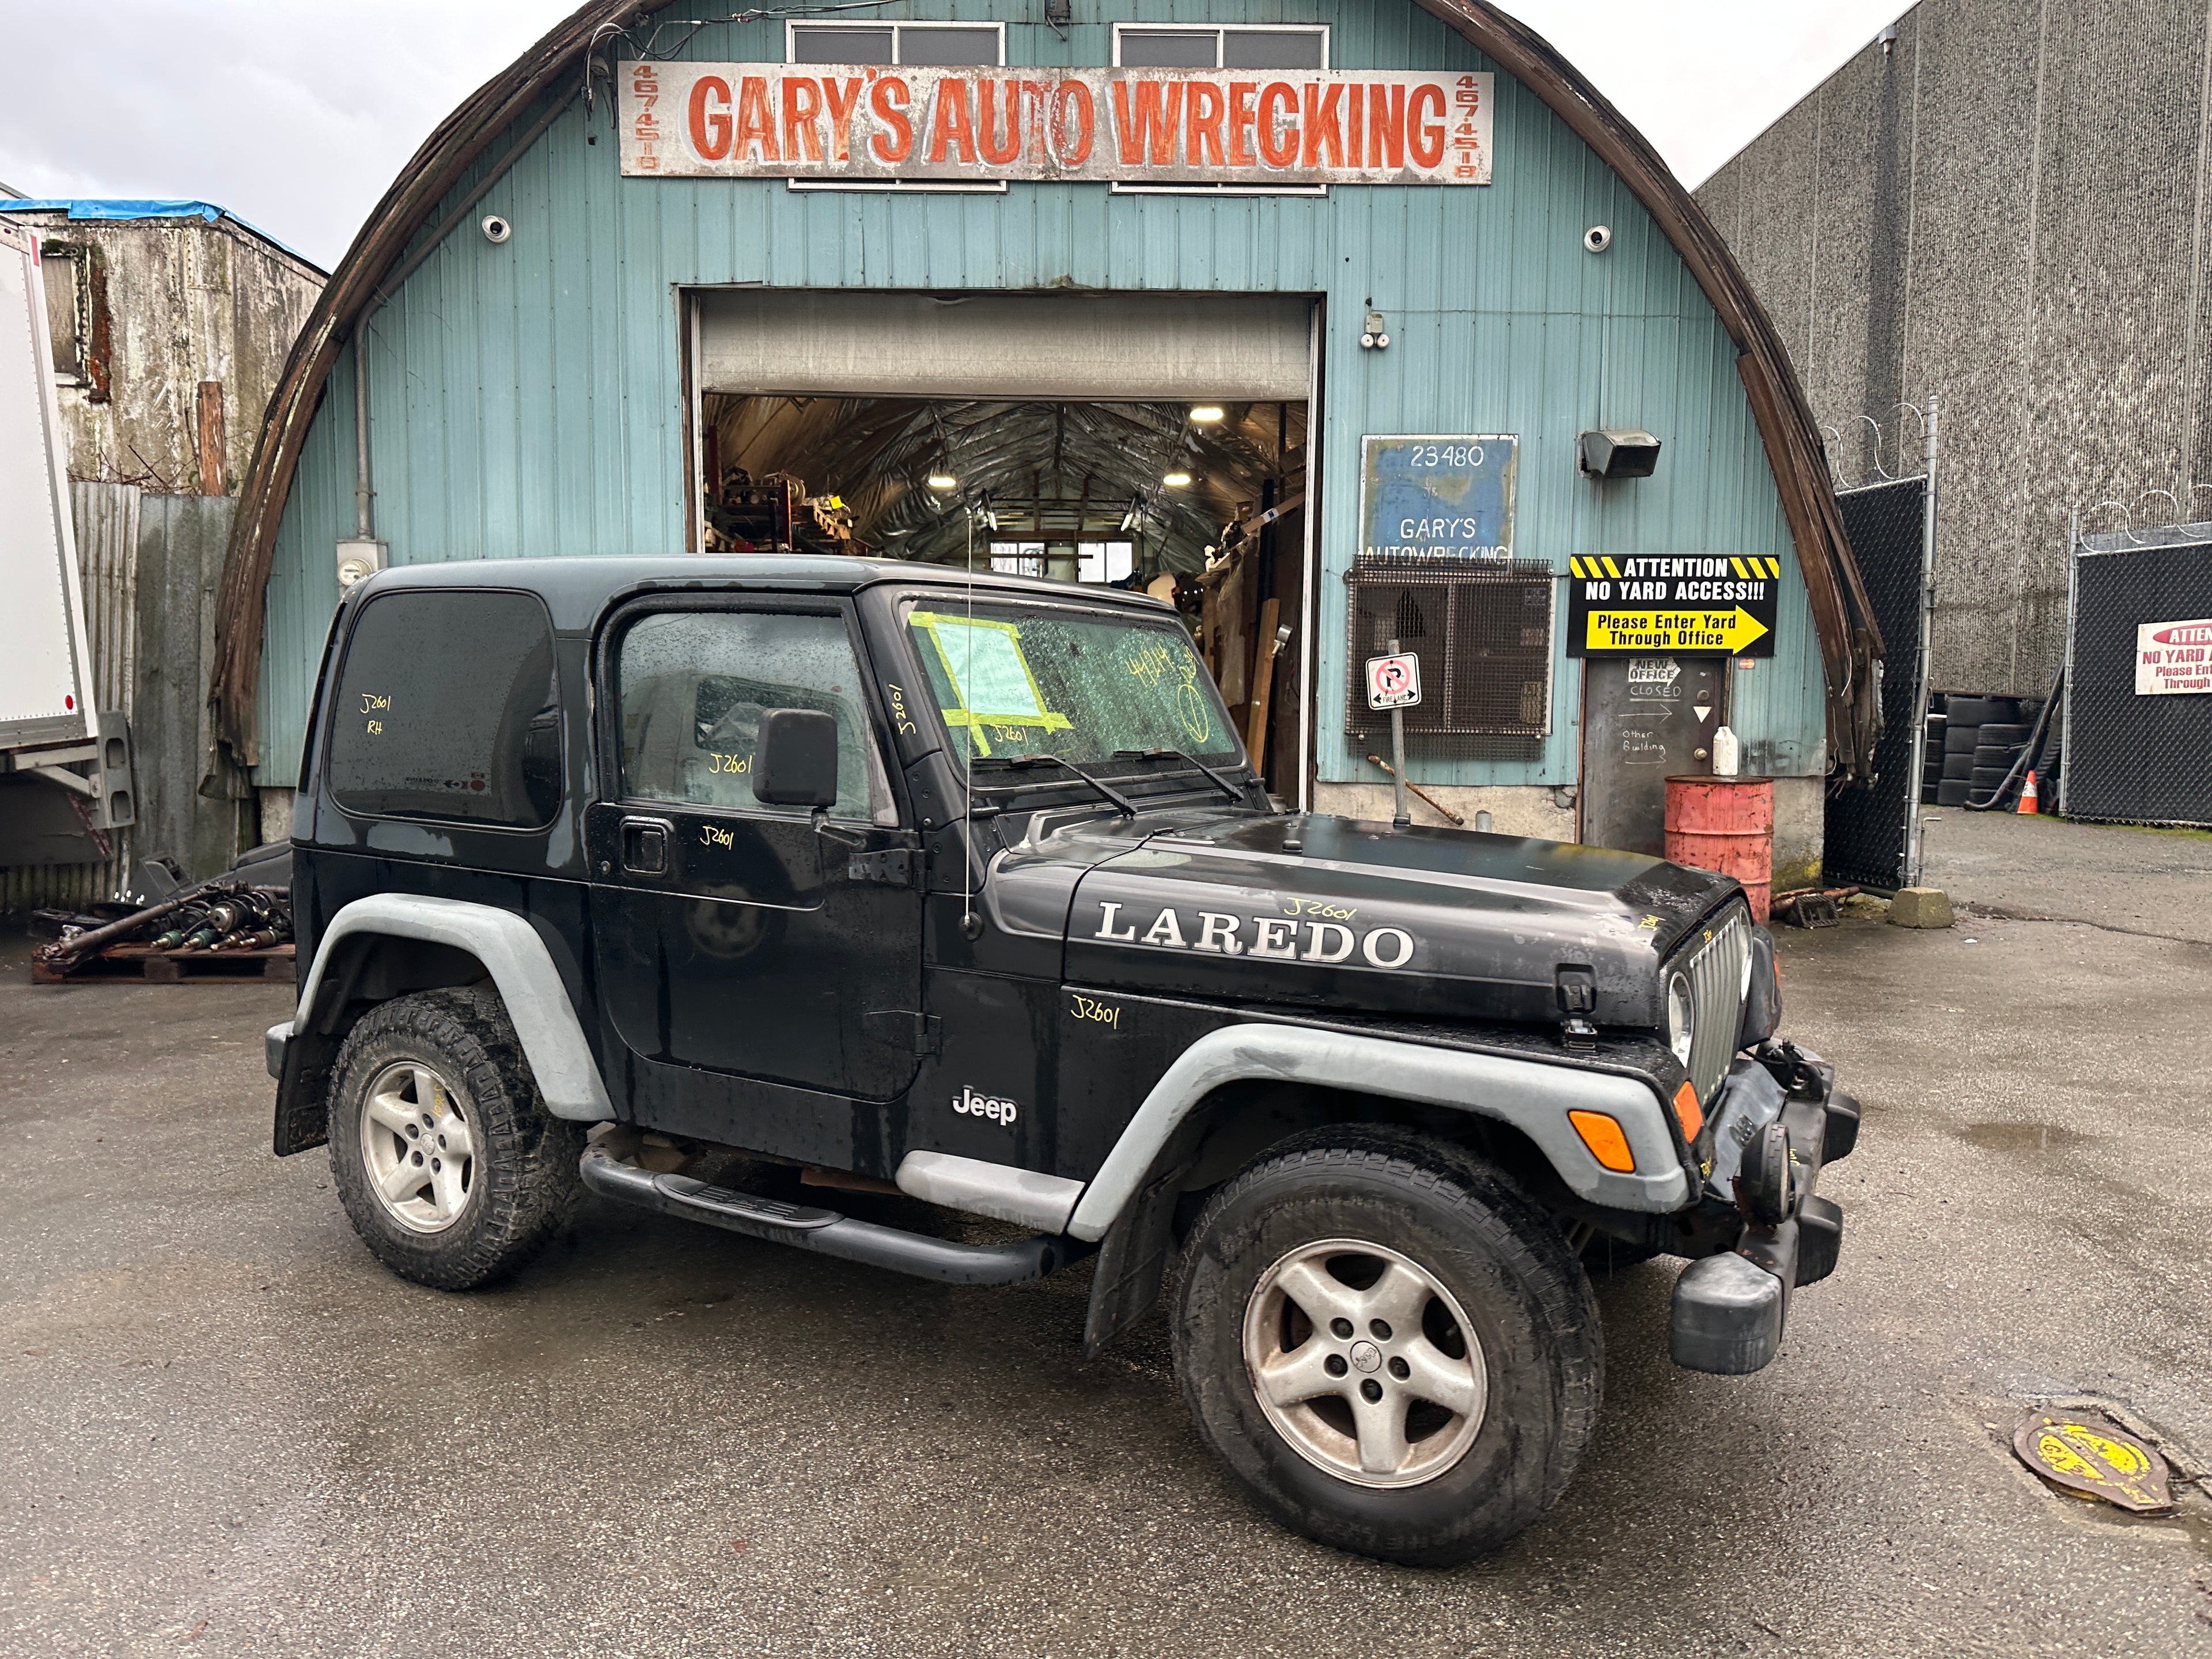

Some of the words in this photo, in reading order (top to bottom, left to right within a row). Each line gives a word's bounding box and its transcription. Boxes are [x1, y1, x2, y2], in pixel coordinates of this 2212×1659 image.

[688, 69, 912, 161] GARY'S
[930, 78, 1094, 165] AUTO
[1112, 79, 1447, 168] WRECKING
[1411, 446, 1484, 466] 23480
[1400, 518, 1476, 539] GARY'S
[1624, 558, 1728, 577] ATTENTION
[1585, 581, 1611, 600] NO
[1620, 581, 1666, 600] YARD
[1675, 582, 1764, 600] ACCESS!!!
[1598, 615, 1647, 629] Please
[1655, 615, 1696, 629] Enter
[1703, 614, 1736, 629] Yard
[1609, 631, 1671, 647] Through
[1677, 631, 1723, 645] Office
[1637, 658, 1668, 669] NEW
[2143, 651, 2161, 664] NO
[2165, 649, 2205, 663] YARD
[1630, 669, 1675, 679] OFFICE
[2156, 666, 2192, 677] Please
[1630, 685, 1681, 697] CLOSED
[2164, 677, 2210, 689] Through
[360, 693, 391, 714] J2601
[889, 684, 916, 734] J2601
[367, 720, 382, 735] RH
[1622, 729, 1653, 738] Other
[1623, 740, 1666, 755] Building
[709, 753, 753, 774] J2601
[700, 825, 734, 850] J2601
[1284, 897, 1357, 921] J2601
[1094, 902, 1415, 969] LAREDO
[1070, 995, 1120, 1030] J2601
[952, 1085, 1017, 1126] Jeep
[1355, 1347, 1377, 1368] Jeep
